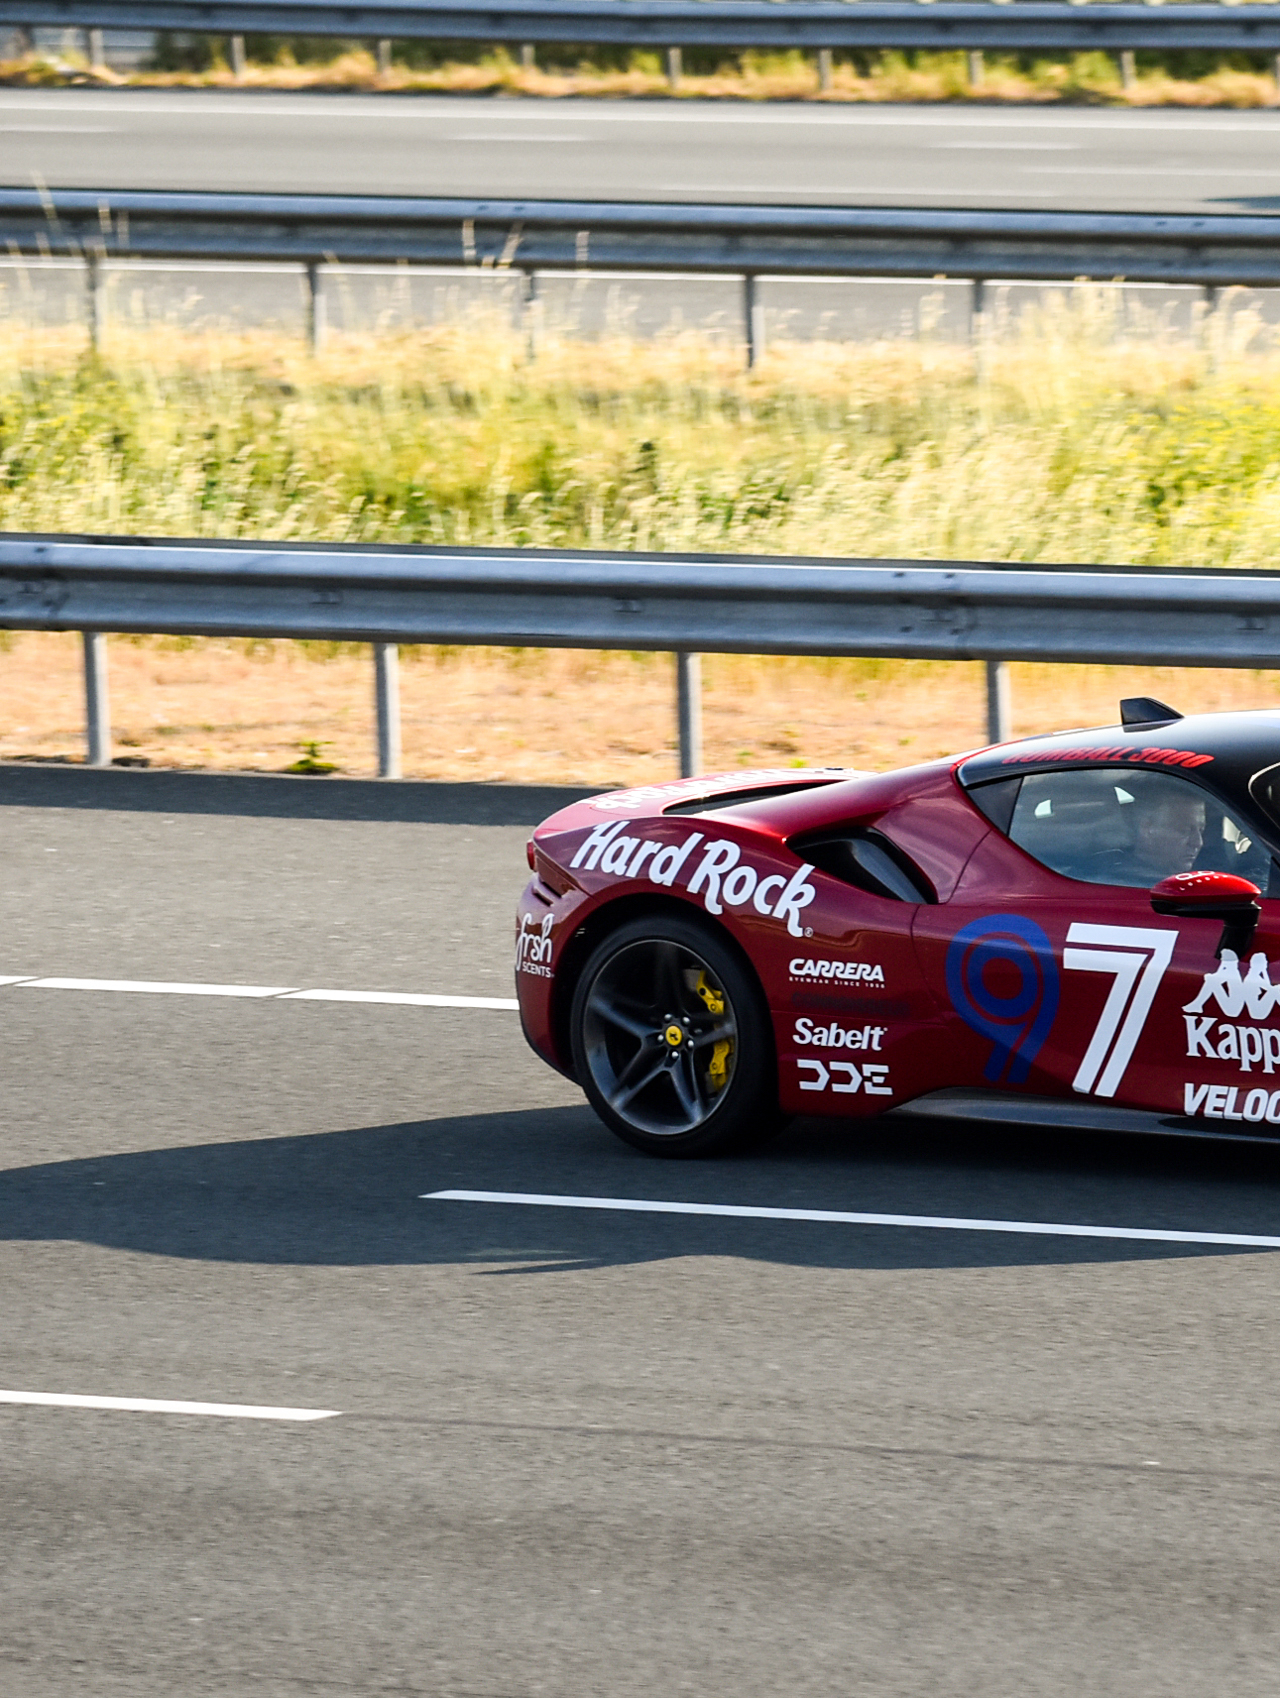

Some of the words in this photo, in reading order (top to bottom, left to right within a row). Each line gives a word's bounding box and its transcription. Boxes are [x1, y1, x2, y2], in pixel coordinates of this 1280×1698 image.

[1127, 747, 1214, 768] 3000
[569, 820, 704, 887] Hard
[687, 838, 816, 937] Rock
[522, 961, 551, 978] SCENTS
[789, 957, 885, 982] CARRERA
[792, 1017, 884, 1051] Sabelt
